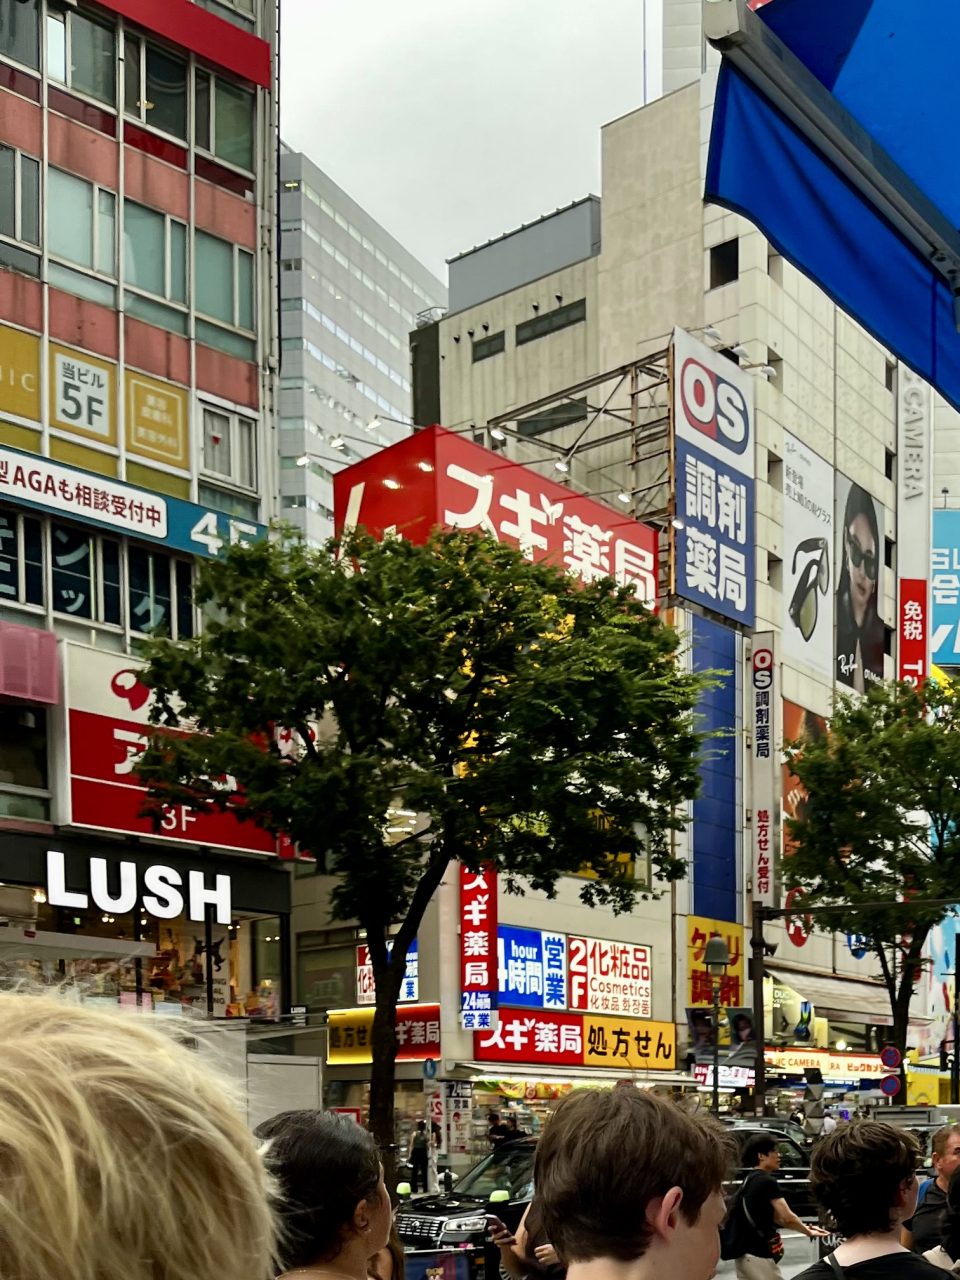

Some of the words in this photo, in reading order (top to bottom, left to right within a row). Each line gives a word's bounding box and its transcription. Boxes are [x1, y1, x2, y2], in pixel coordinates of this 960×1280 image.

[62, 361, 105, 390] 当ビル
[61, 382, 104, 426] 5F
[683, 359, 747, 447] OS
[904, 387, 924, 500] CAMERA
[685, 454, 746, 545] 調剤
[686, 526, 747, 612] 薬局
[903, 600, 923, 641] 免税
[161, 803, 196, 832] 3F
[757, 809, 770, 894] 処方せん受付
[46, 851, 232, 924] LUSH
[463, 866, 489, 986] スギ薬局
[511, 940, 538, 960] hour
[590, 941, 649, 981] 化粧品
[507, 959, 543, 996] 時間
[544, 936, 565, 1006] 営業
[569, 939, 588, 1008] 2F
[590, 977, 650, 998] Cosmetics
[463, 992, 477, 1010] 24
[463, 1013, 490, 1028] 営業
[479, 1018, 582, 1055] スギ薬局
[588, 1025, 672, 1060] 処方せん
